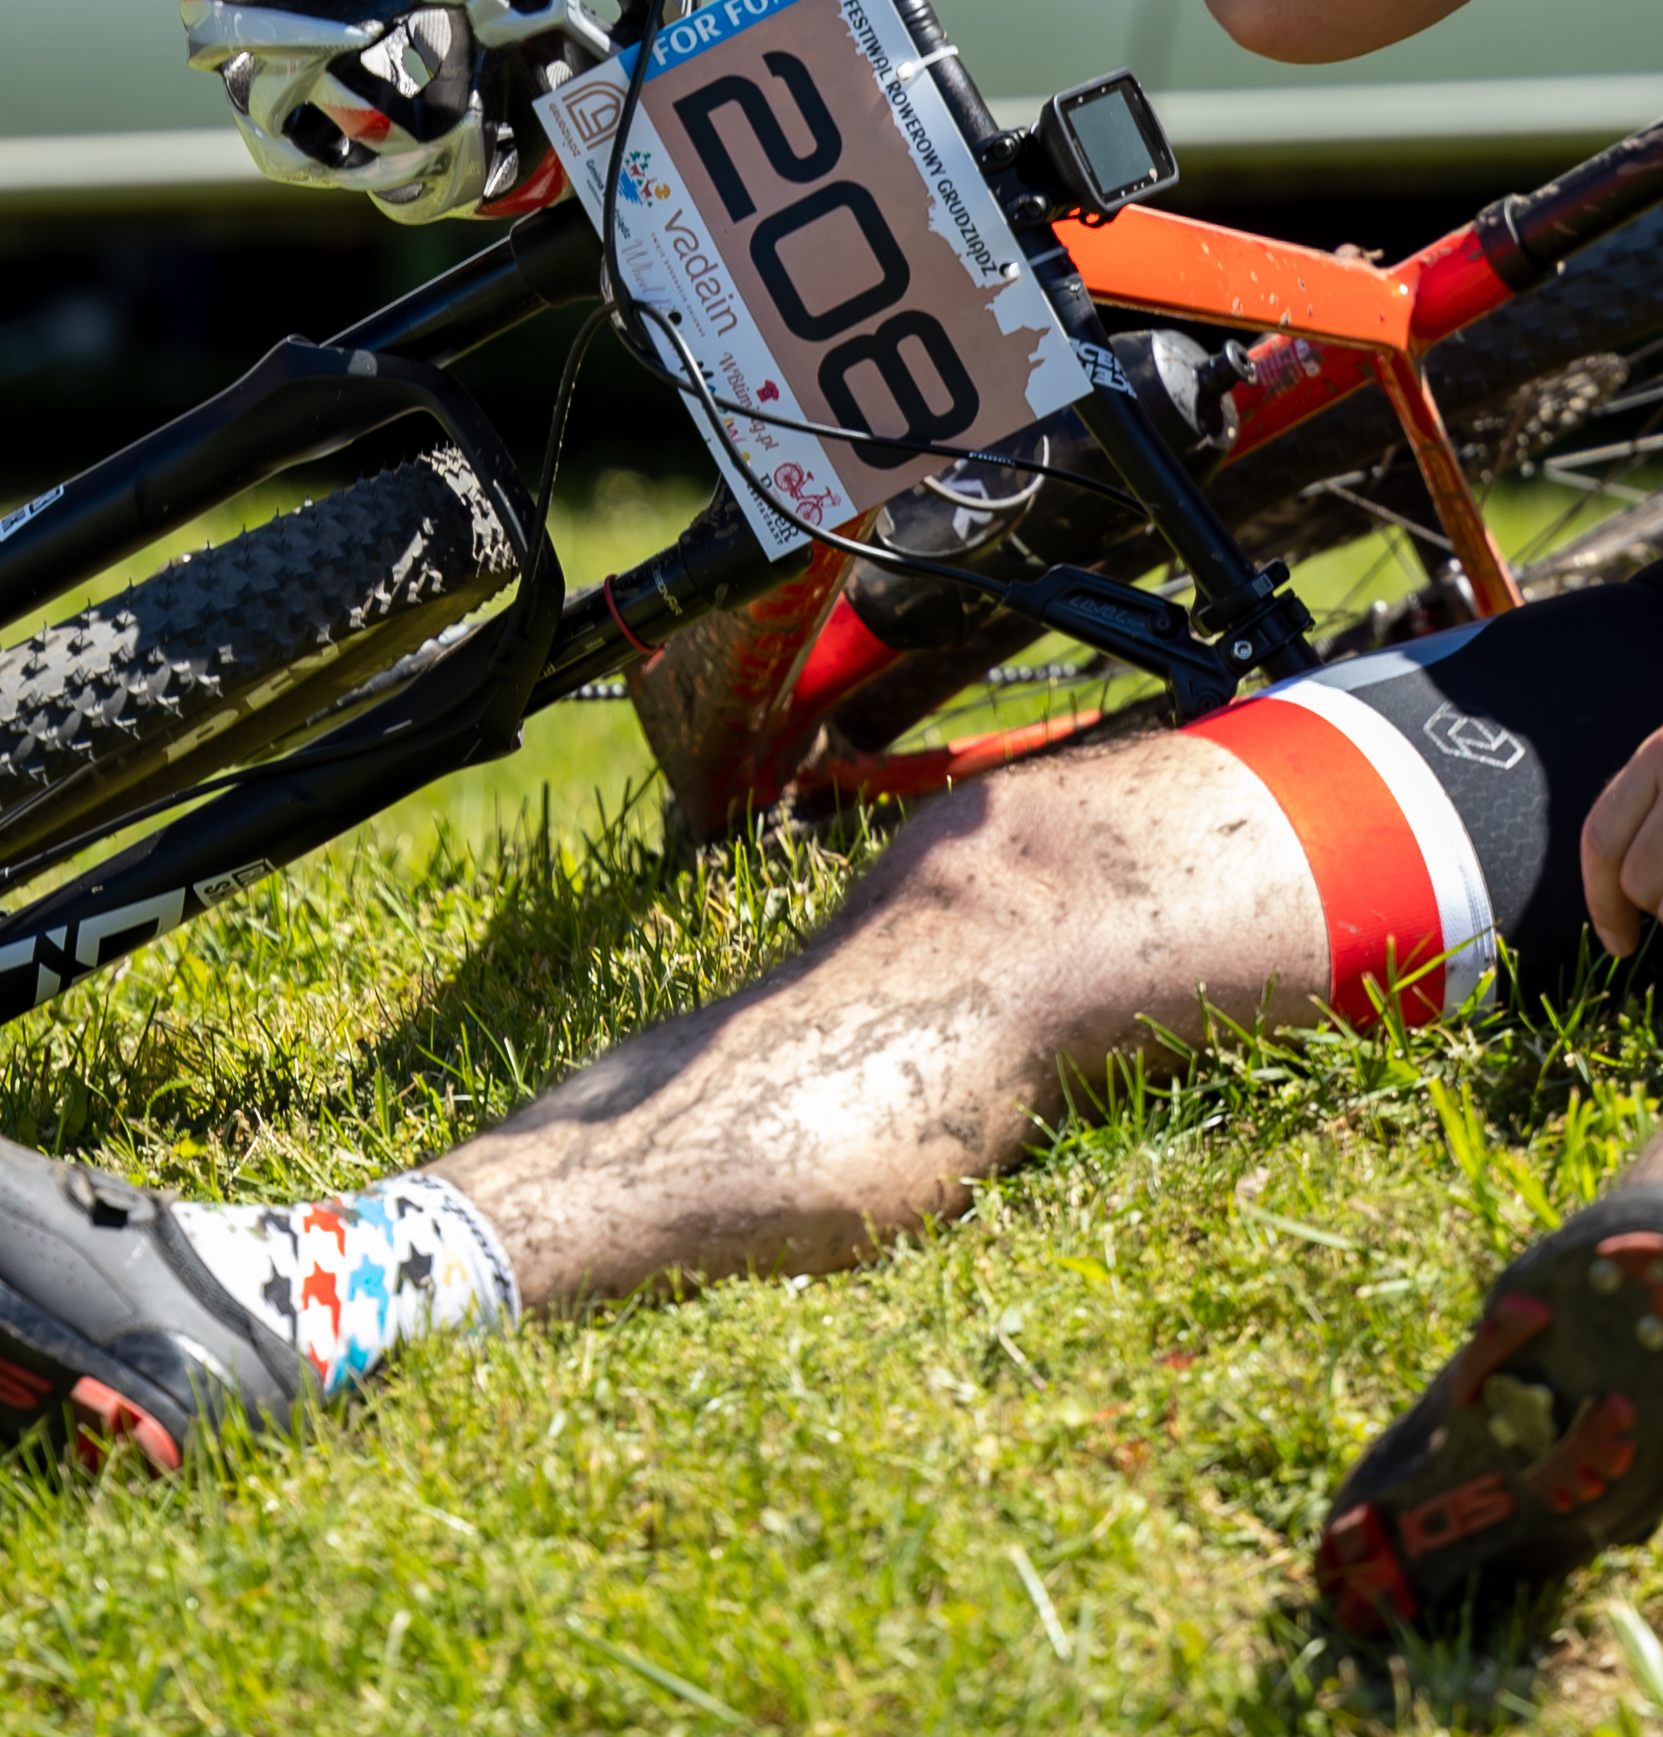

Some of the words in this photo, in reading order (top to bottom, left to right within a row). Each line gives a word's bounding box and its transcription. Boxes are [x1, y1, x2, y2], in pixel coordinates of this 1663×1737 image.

[651, 10, 720, 67] FOR
[671, 49, 981, 470] 208
[884, 79, 945, 179] ROWEROWY
[935, 177, 997, 278] GRUDZIĄDZ
[663, 207, 739, 337] vadain
